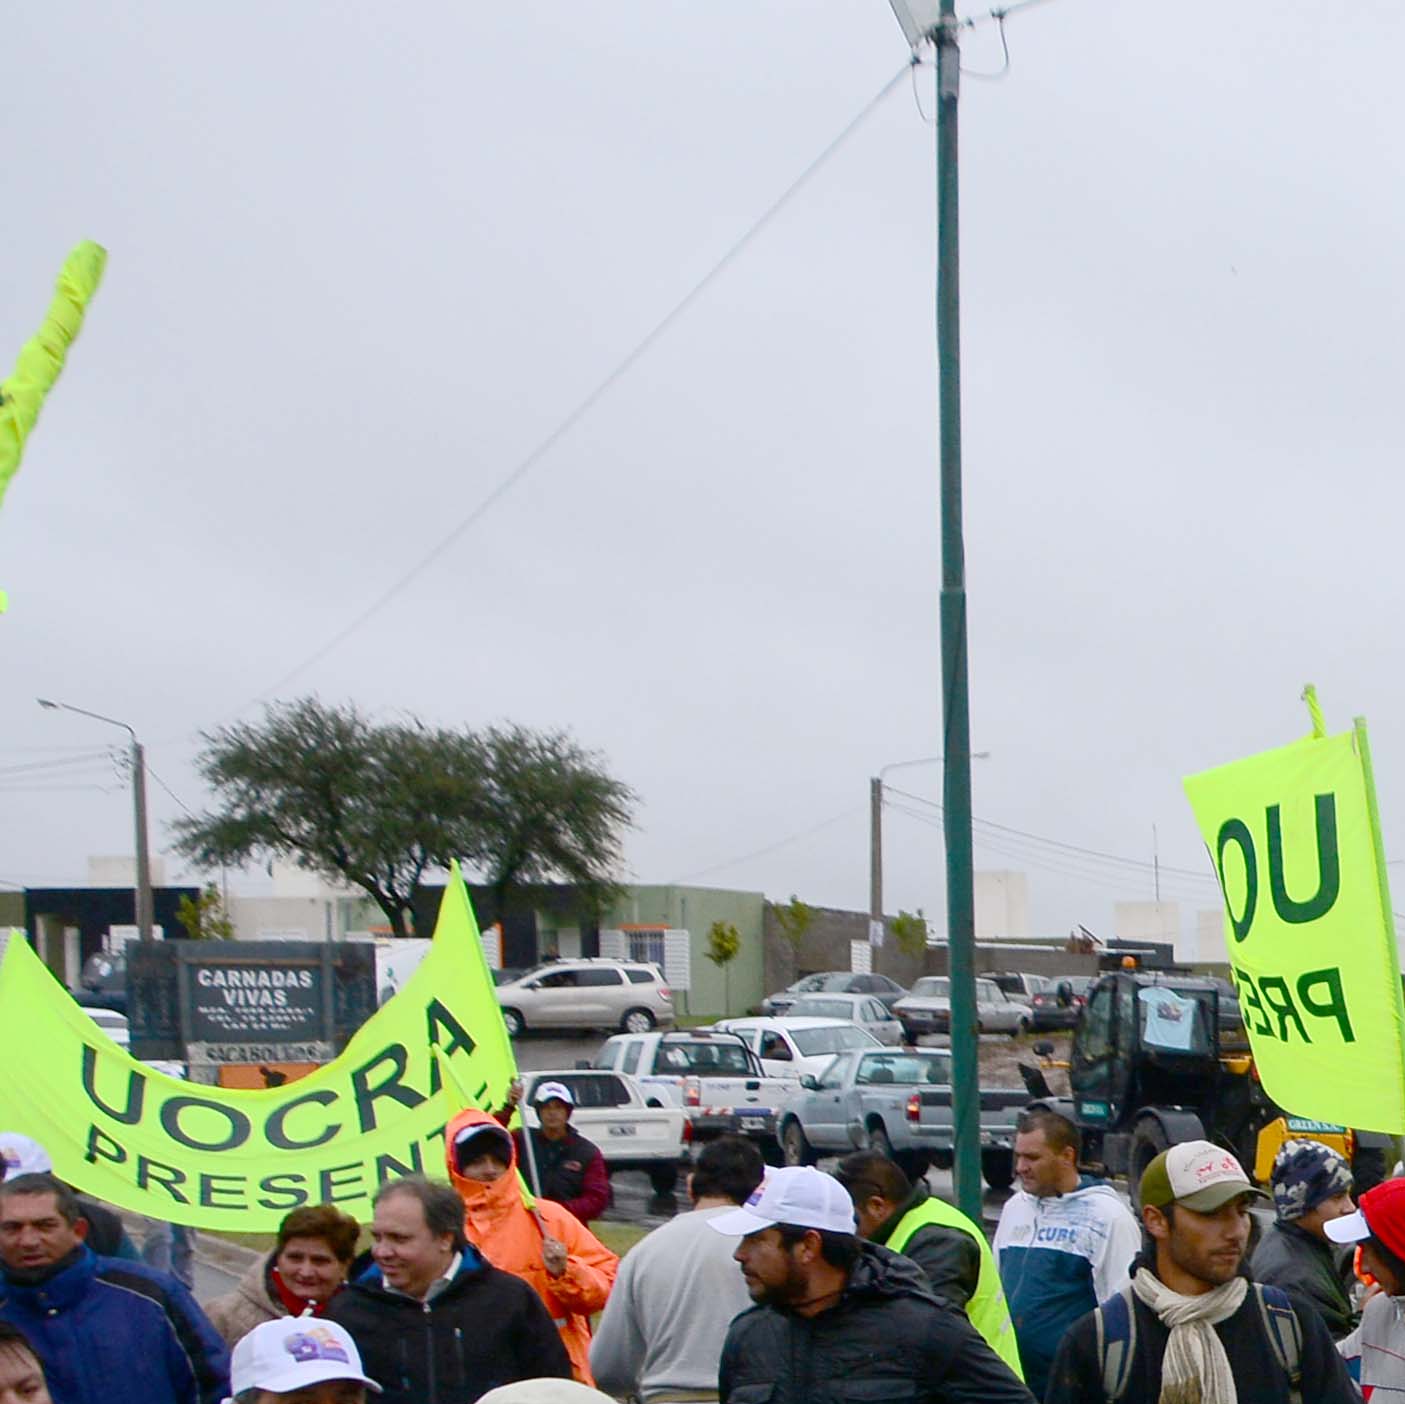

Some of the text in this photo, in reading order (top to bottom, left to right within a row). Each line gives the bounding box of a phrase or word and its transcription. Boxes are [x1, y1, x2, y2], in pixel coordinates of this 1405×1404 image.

[197, 969, 314, 988] CARNADAS
[222, 988, 289, 1007] VIVAS
[80, 997, 477, 1152] UOCRA
[84, 1081, 493, 1210] PRESEN
